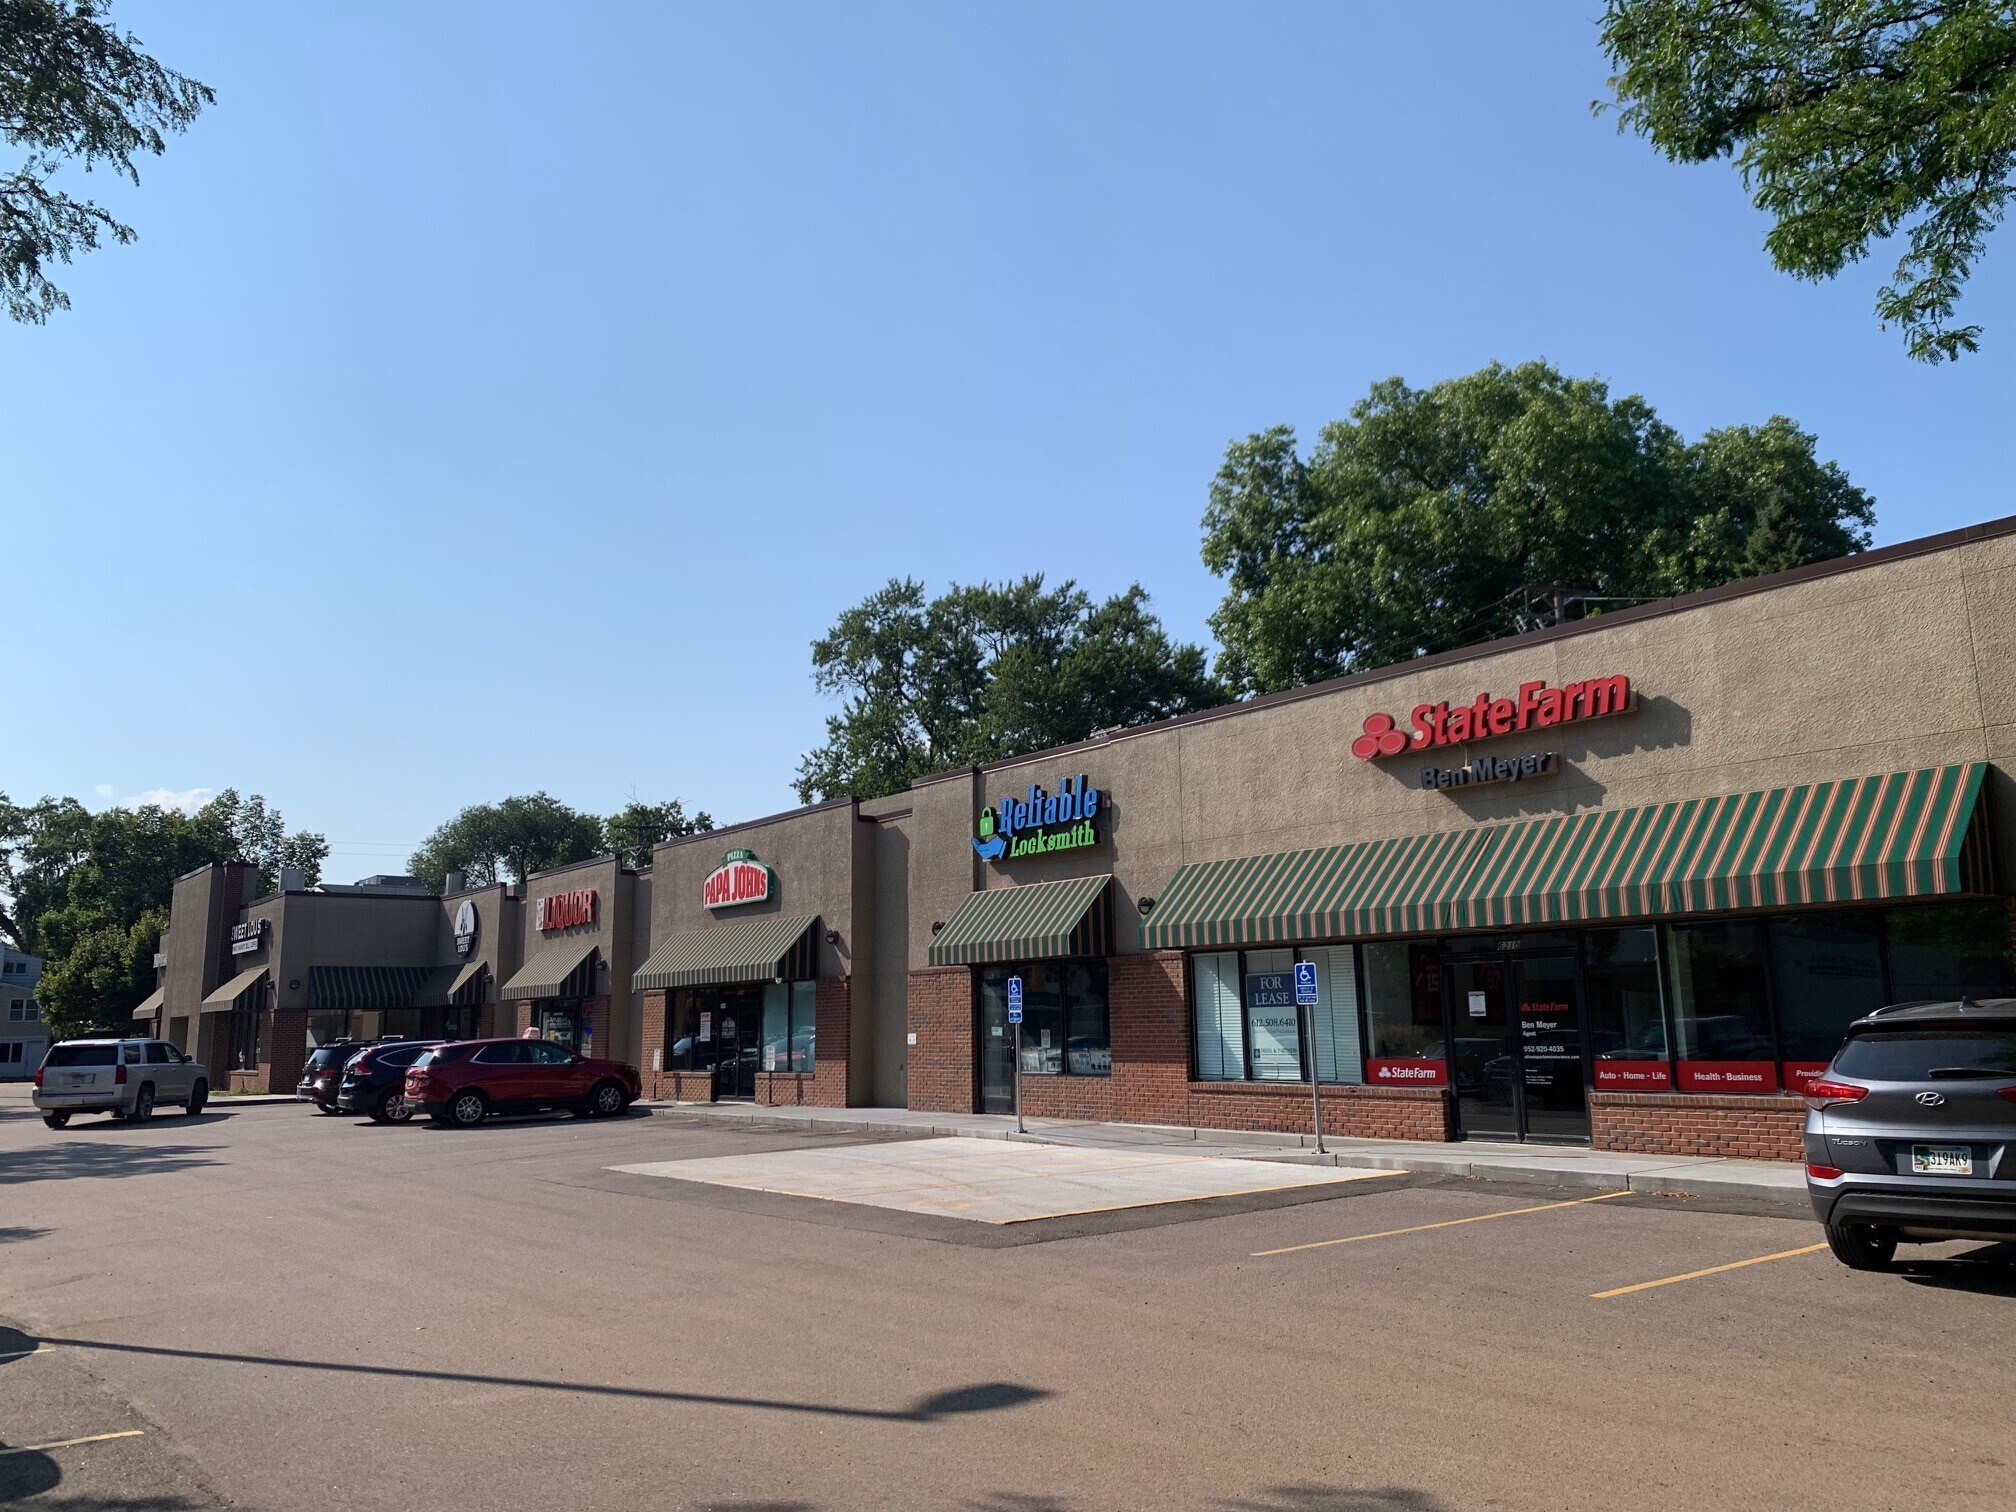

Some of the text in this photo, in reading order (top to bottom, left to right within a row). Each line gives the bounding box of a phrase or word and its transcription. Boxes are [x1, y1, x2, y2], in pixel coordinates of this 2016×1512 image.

[1411, 674, 1628, 749] StateFarm
[1421, 755, 1546, 790] Ben Meyer
[998, 774, 1098, 837] Reliable
[1009, 820, 1096, 858] Locksmith
[728, 851, 744, 861] PIZZA
[705, 865, 766, 905] PAPA JOHNS
[544, 889, 593, 929] LIQUOR
[231, 922, 247, 941] SWEET
[457, 936, 469, 945] SWEET
[1260, 976, 1283, 990] FOR
[1255, 992, 1290, 1006] LEASE
[1251, 1018, 1296, 1027] 612.508.6410
[1521, 1021, 1557, 1030] Ben Meyer
[1523, 1045, 1564, 1053] 952-920-4035
[1600, 1071, 1667, 1080] Auto Home Life
[1694, 1072, 1763, 1082] Health Business
[1929, 1151, 1968, 1167] 319AK9
